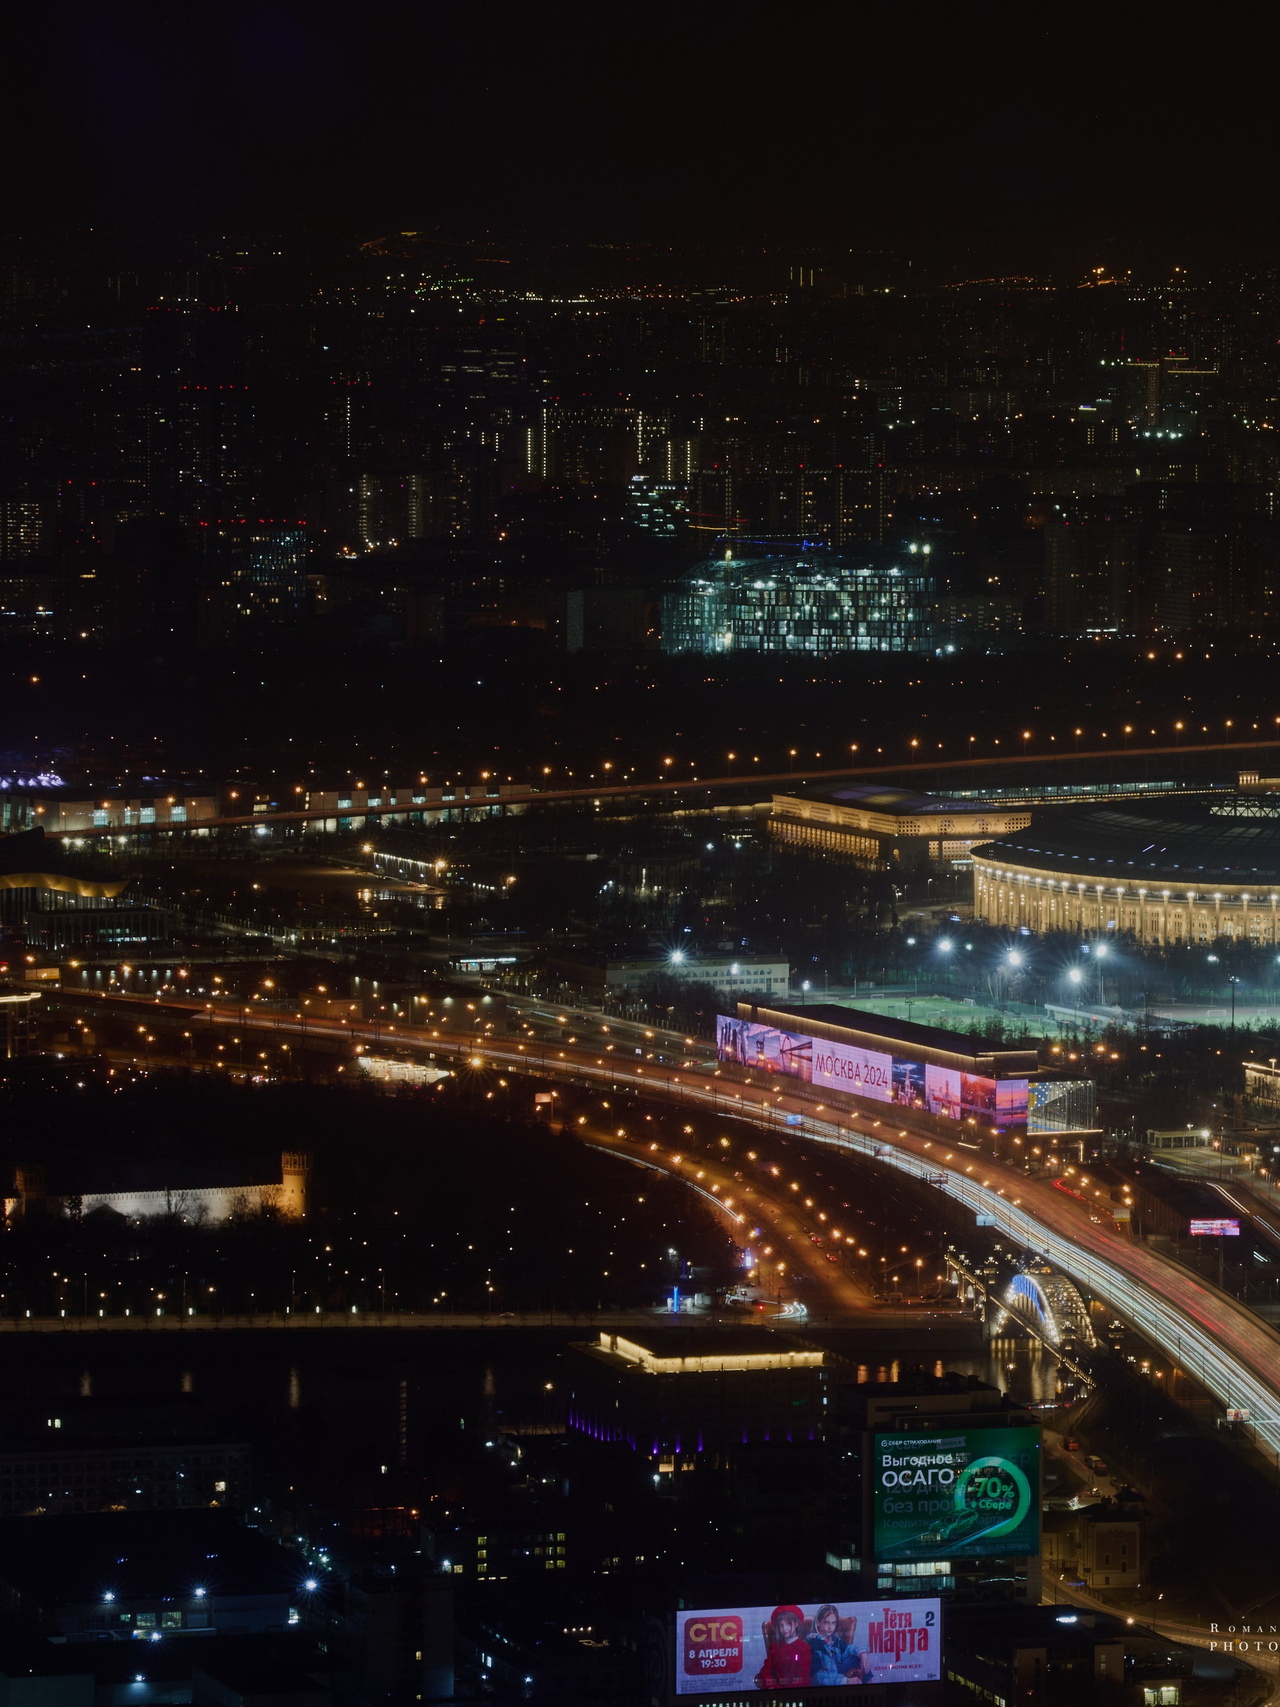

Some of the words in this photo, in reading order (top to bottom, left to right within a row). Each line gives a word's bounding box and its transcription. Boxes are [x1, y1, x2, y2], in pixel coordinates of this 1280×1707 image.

[815, 1053, 862, 1082] МОСКВА
[863, 1065, 889, 1088] 2024
[903, 1438, 942, 1446] СТРАХОВАНИЕ
[882, 1453, 953, 1467] Выгодное
[882, 1468, 954, 1487] ОСАГО
[979, 1499, 1012, 1511] Сбере
[883, 1607, 912, 1629] Тётя
[925, 1610, 935, 1627] 2
[689, 1622, 738, 1643] СТС
[868, 1621, 929, 1663] Марта
[688, 1650, 696, 1659] 8
[698, 1647, 739, 1659] АПРЕЛЯ
[700, 1658, 727, 1668] 19:30
